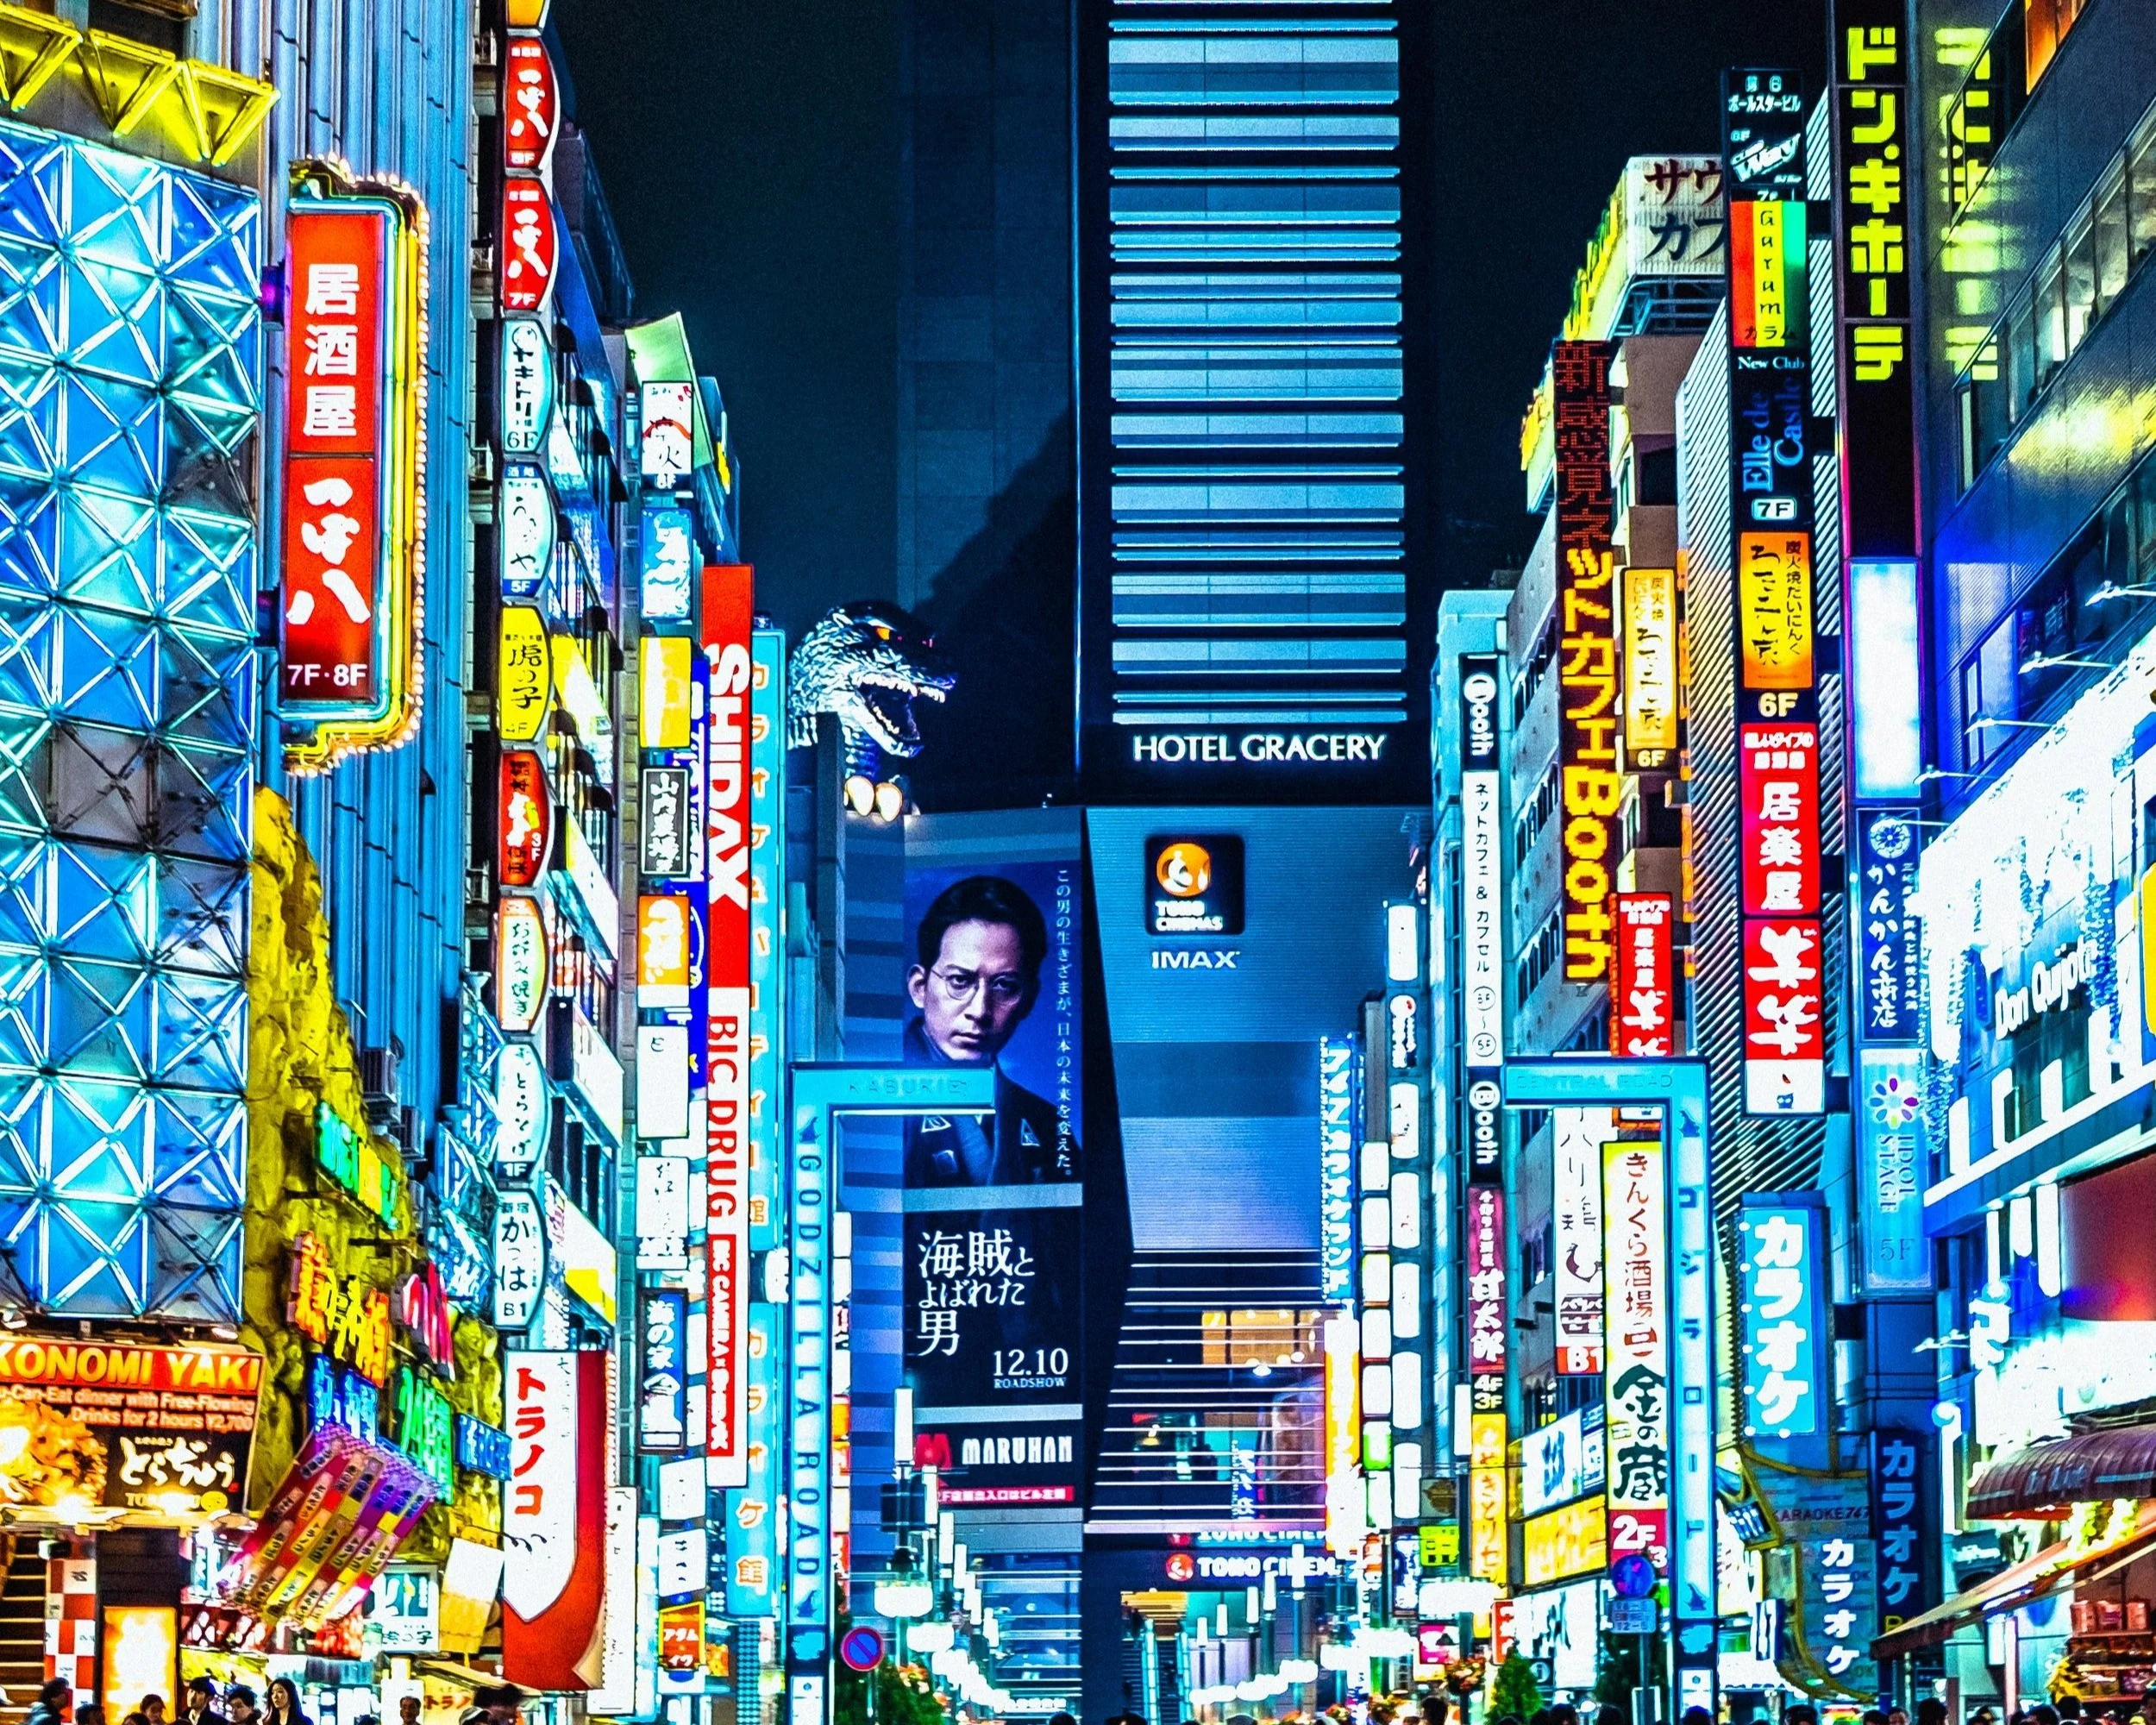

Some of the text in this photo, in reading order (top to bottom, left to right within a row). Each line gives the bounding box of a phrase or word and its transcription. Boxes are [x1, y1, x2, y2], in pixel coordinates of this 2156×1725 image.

[304, 263, 360, 437] 居酒屋
[1738, 355, 1805, 370] New Club
[507, 430, 539, 448] 6F
[1742, 434, 1773, 492] Elle
[1757, 501, 1791, 518] 7F
[286, 478, 371, 625] つぼ八
[511, 580, 531, 593] 5F
[508, 643, 542, 710] 虎の子
[1758, 693, 1798, 718] 6F
[1133, 734, 1387, 762] HOTEL GRACERY
[1636, 748, 1667, 768] 6F
[705, 643, 750, 911] SHIDAX
[1150, 950, 1238, 969] IMAX
[707, 1015, 738, 1218] BIC DRUG
[1624, 1152, 1654, 1319] きんくら酒場
[1880, 1237, 1915, 1261] 5F
[918, 1228, 1036, 1279] 海賊と
[918, 1277, 1025, 1309] よばれた
[503, 1302, 528, 1318] B1
[1753, 1216, 1810, 1426] カラオケ
[916, 1309, 961, 1357] 男
[166, 1346, 260, 1390] YAKI
[796, 1155, 822, 1576] GODZILLA ROAD
[993, 1347, 1069, 1377] 12.10
[74, 1388, 126, 1406] dinner
[126, 1391, 159, 1408] with
[993, 1377, 1068, 1389] ROADSHOW
[1473, 1373, 1503, 1391] 4F
[1473, 1392, 1503, 1410] 3F
[71, 1407, 121, 1424] Drinks
[122, 1408, 145, 1426] for
[146, 1411, 159, 1427] 2
[160, 1411, 204, 1428] hours
[1612, 1363, 1669, 1502] 金の蔵
[513, 1367, 546, 1516] トラノコ
[962, 1435, 1073, 1465] MARUHAN
[1611, 1514, 1657, 1550] 2F
[1881, 1440, 1920, 1605] カラオケ
[1821, 1538, 1860, 1675] カラオケ
